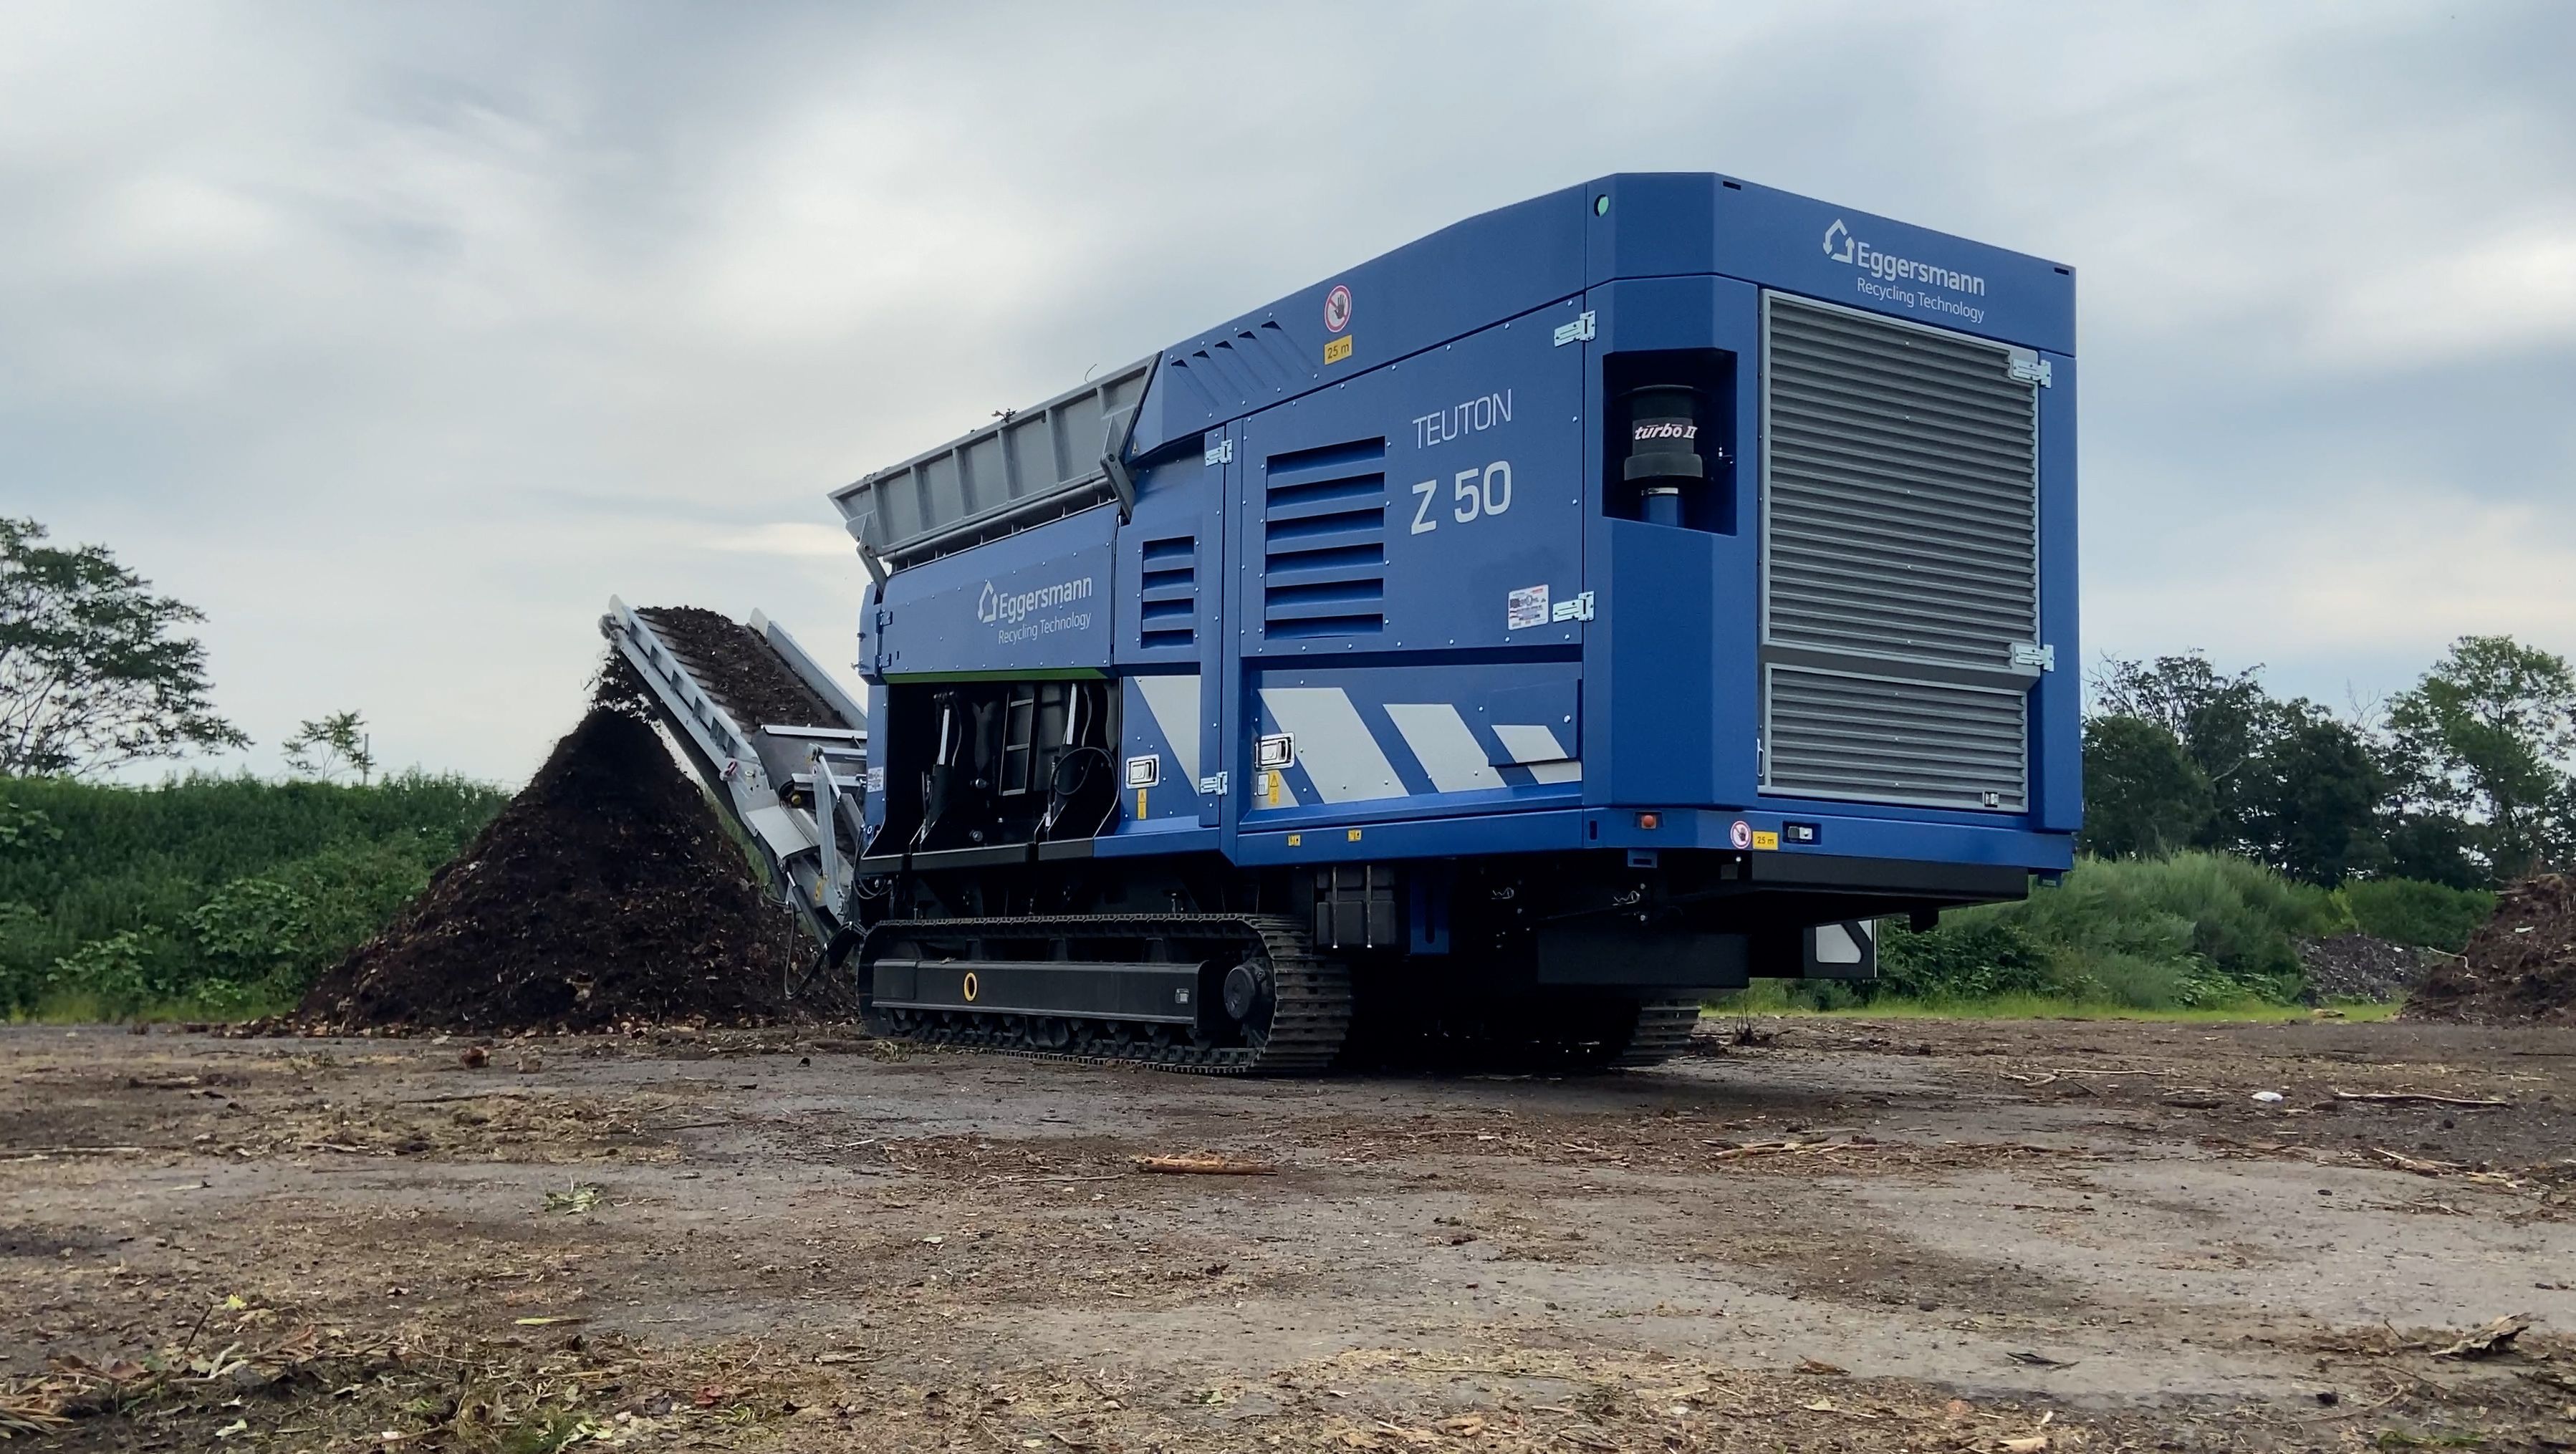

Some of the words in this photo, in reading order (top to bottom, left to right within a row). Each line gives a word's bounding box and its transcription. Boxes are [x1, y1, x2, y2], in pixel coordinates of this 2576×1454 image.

[1857, 241, 1985, 297] Eggersmann
[1857, 277, 1915, 309] Recycling
[1917, 292, 1984, 324] Technology
[1327, 345, 1338, 360] 25
[1341, 344, 1350, 355] m
[1412, 388, 1512, 449] TEUTON
[1411, 479, 1437, 535] Z
[1454, 461, 1512, 524] 50
[999, 577, 1092, 624] Eggersmann
[999, 623, 1038, 645] Recycling
[1039, 612, 1092, 634] Technology
[1756, 836, 1766, 844] 25
